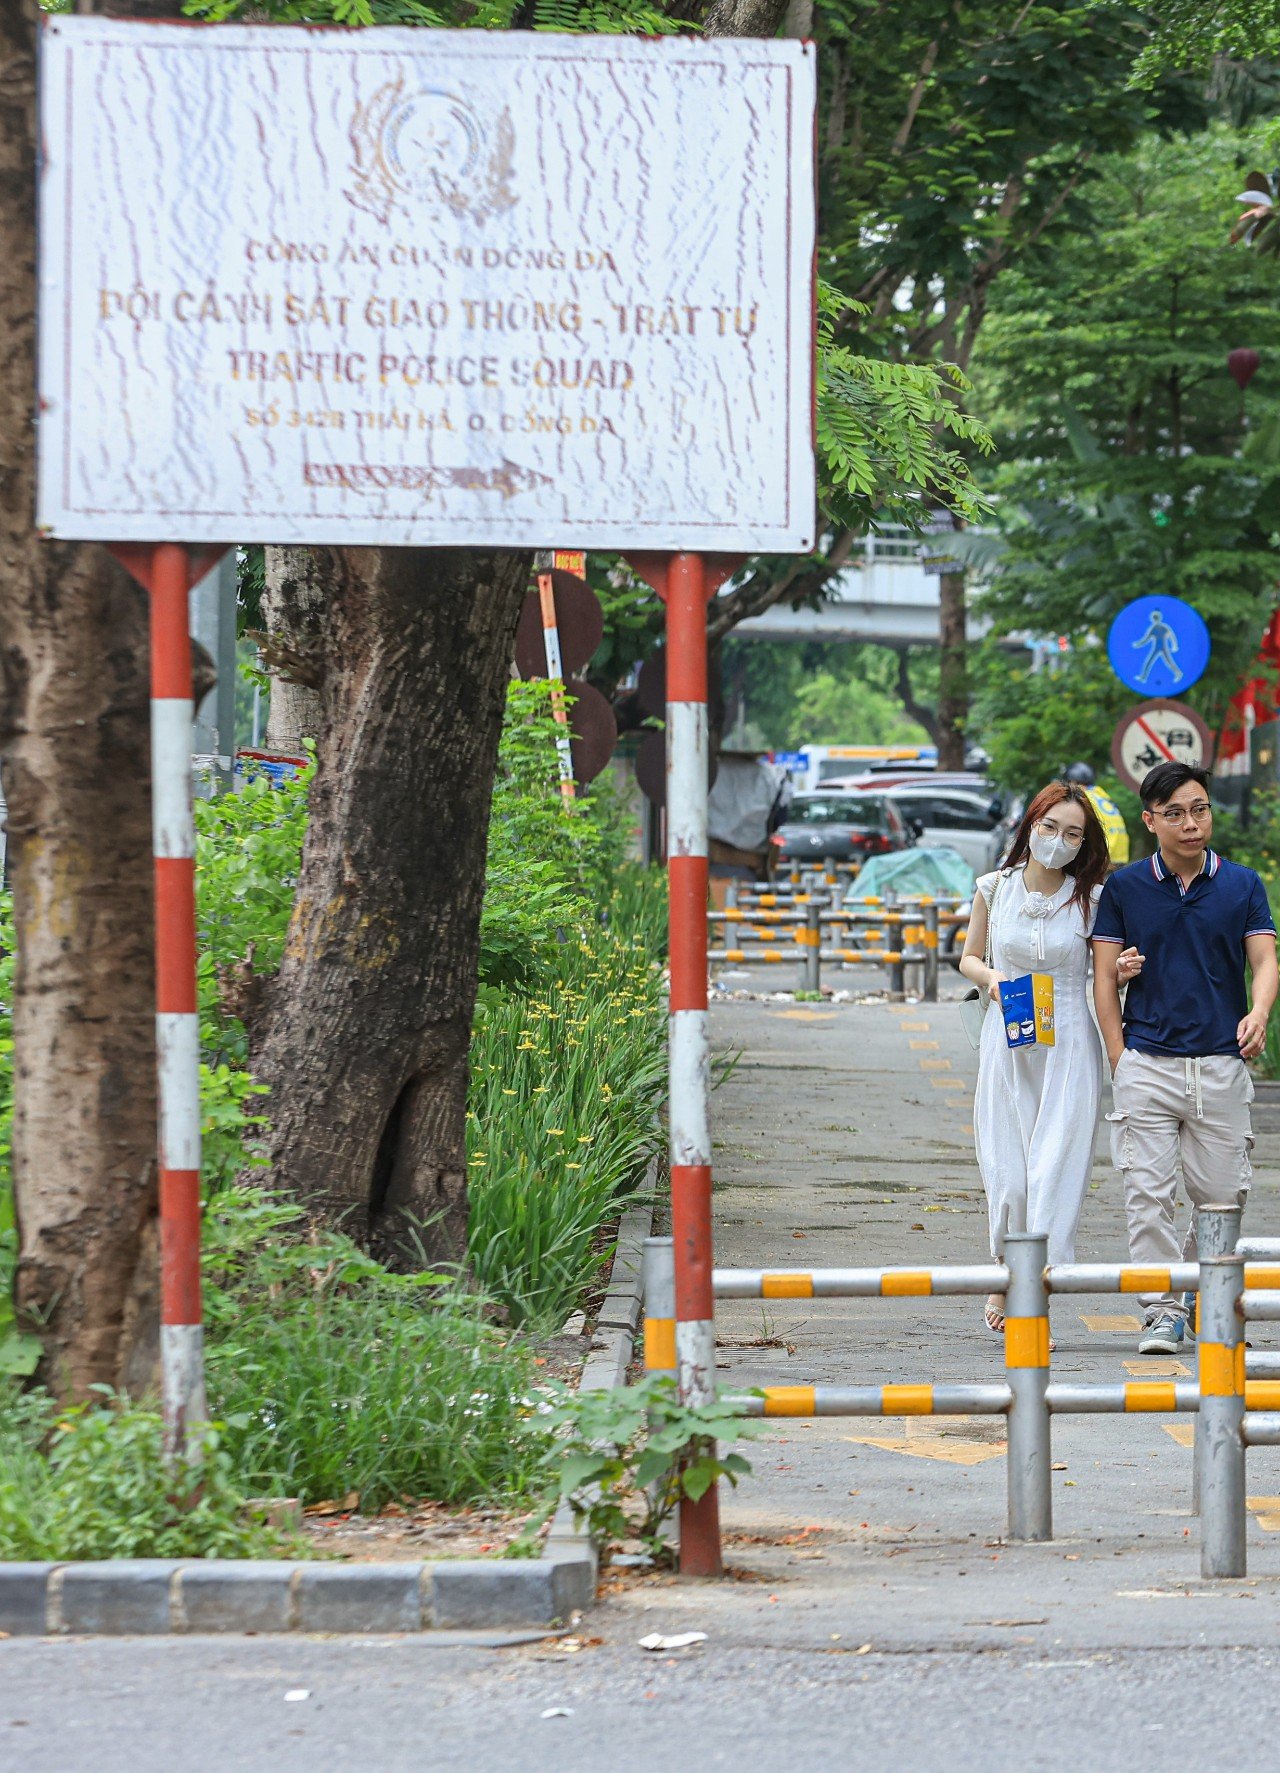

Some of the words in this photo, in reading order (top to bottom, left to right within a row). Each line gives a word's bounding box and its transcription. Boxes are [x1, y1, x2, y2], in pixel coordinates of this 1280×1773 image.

[364, 297, 449, 329] GIAO
[228, 350, 367, 382] TRAFFIC
[379, 353, 499, 387] POLICE
[511, 355, 635, 390] SQUAD
